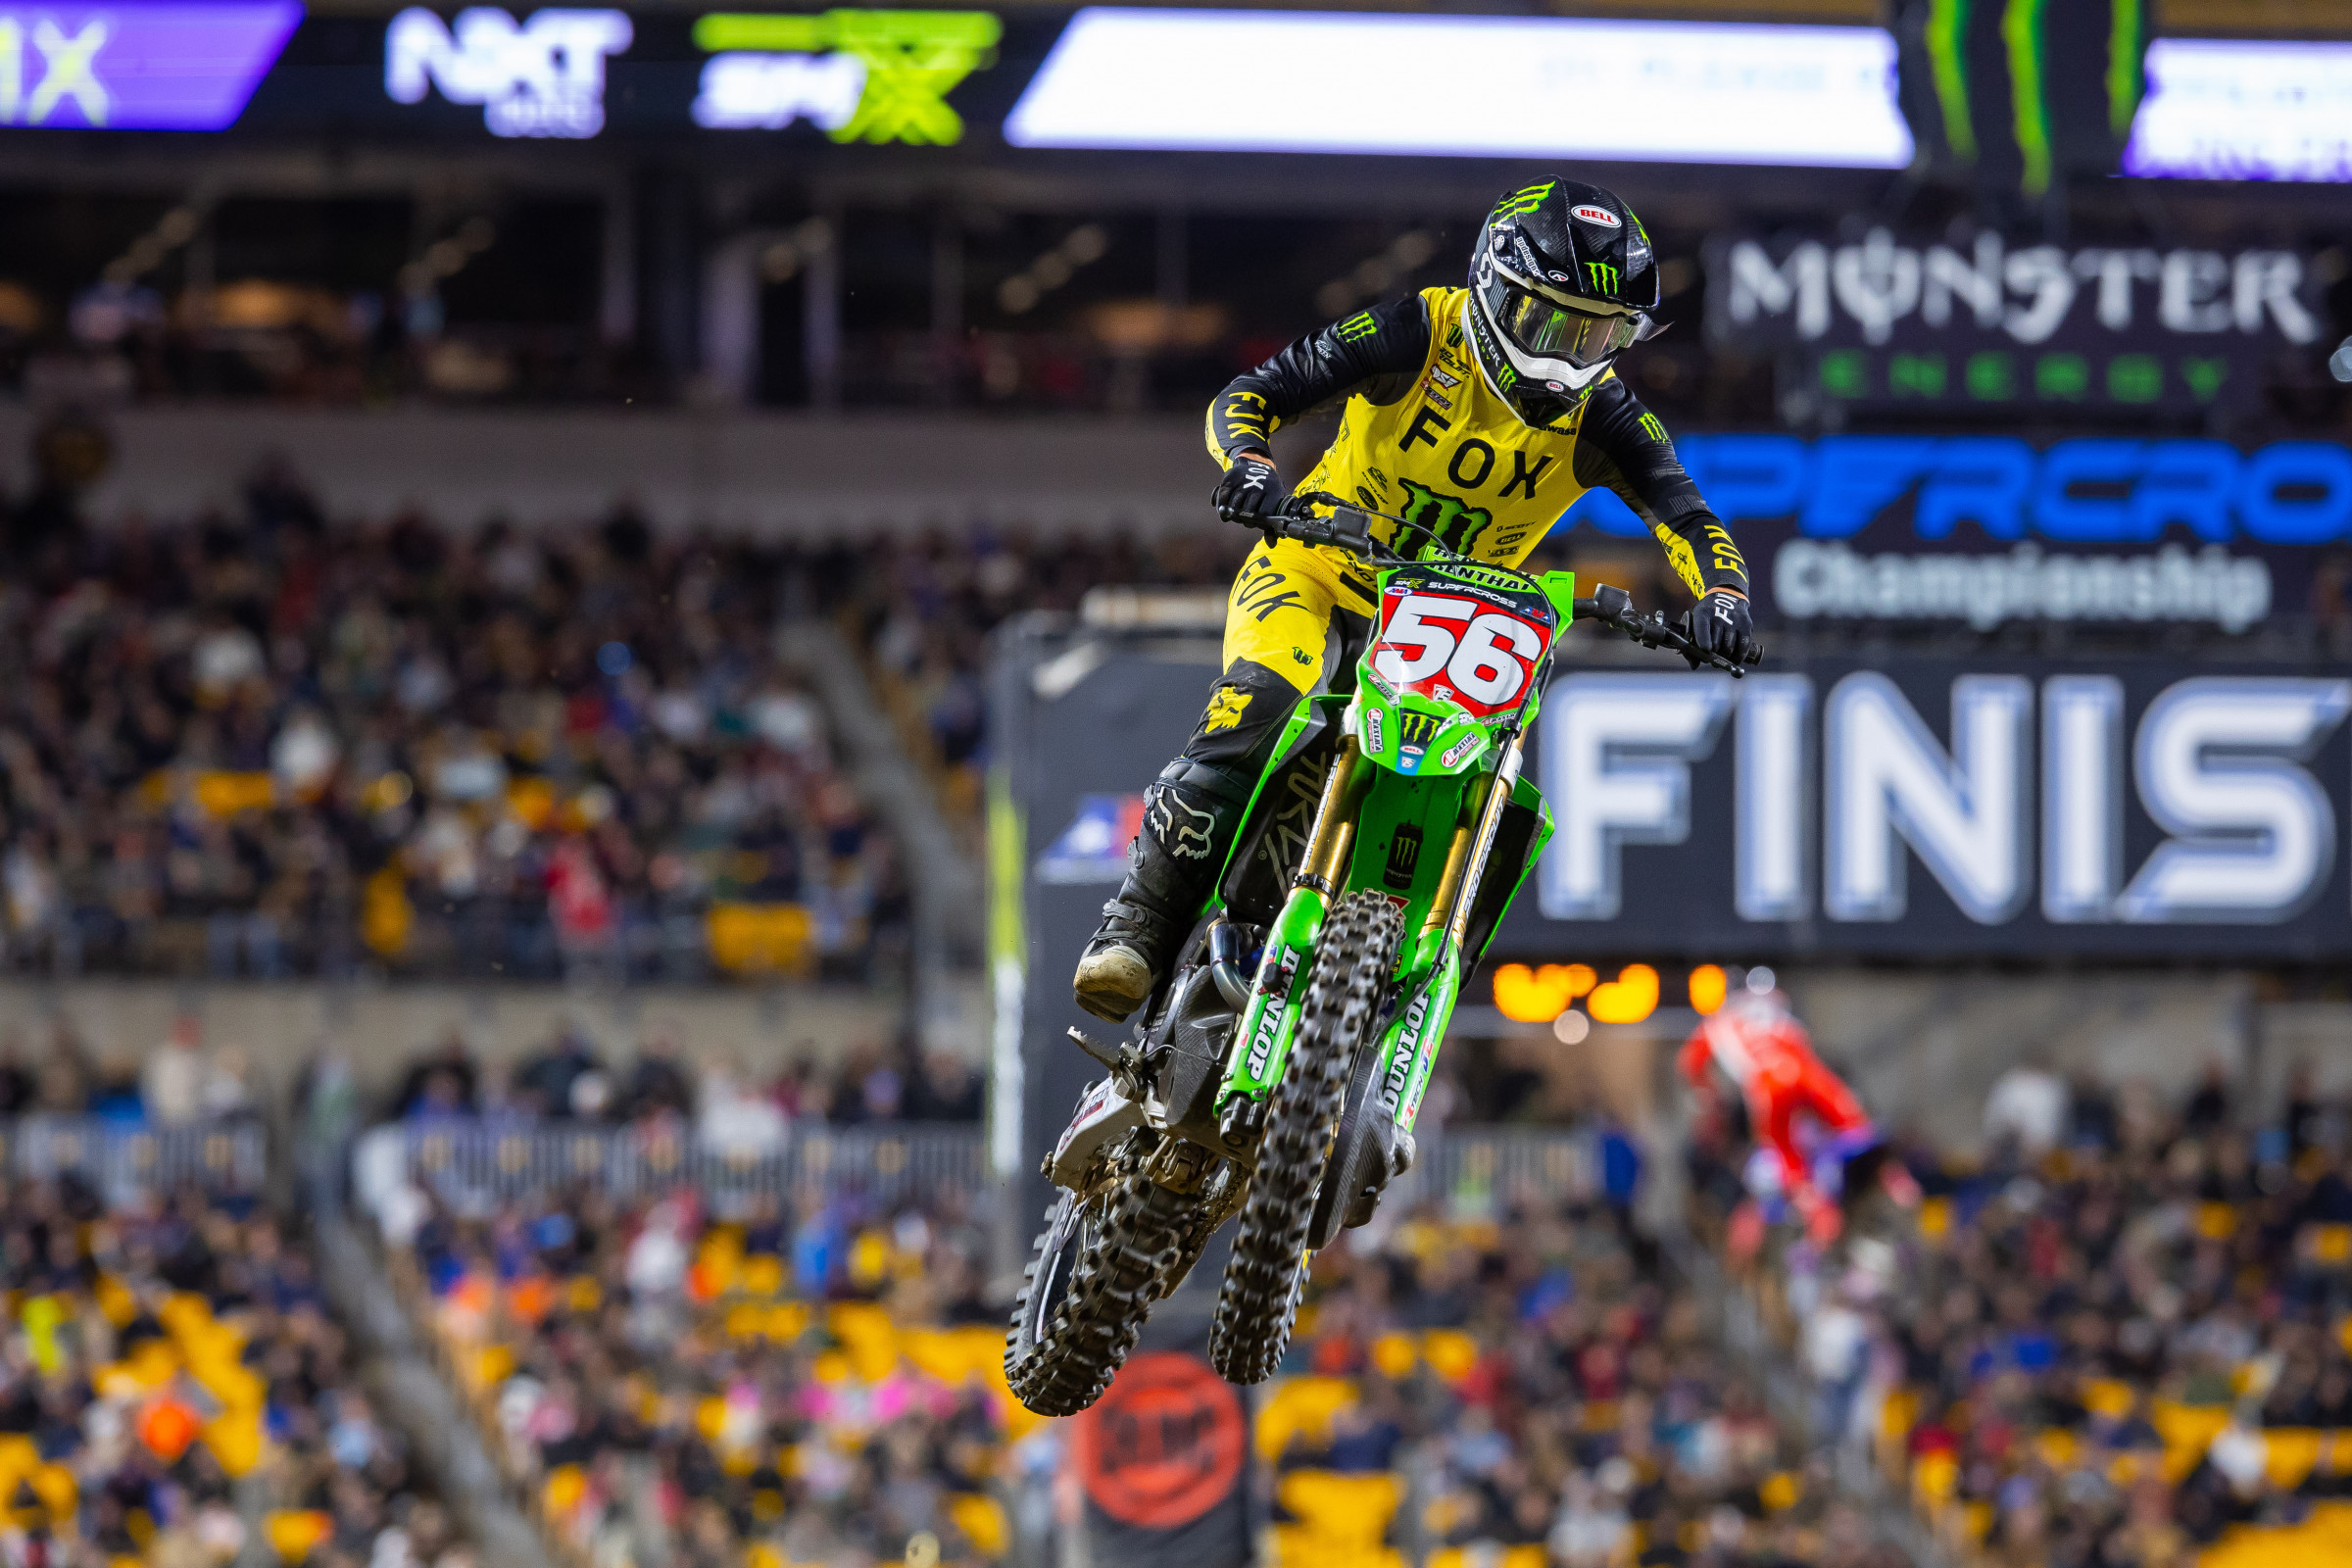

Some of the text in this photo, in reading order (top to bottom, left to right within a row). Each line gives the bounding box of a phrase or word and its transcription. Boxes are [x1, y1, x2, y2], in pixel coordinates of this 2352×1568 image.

[1580, 209, 1615, 224] BELL
[1730, 227, 2319, 345] MONSTER
[1243, 460, 1271, 490] FOX
[1398, 405, 1554, 500] FOX
[1427, 581, 1518, 609] SUPERCROSS
[1715, 591, 1738, 625] FOX
[1772, 538, 2271, 632] Championship
[1374, 595, 1542, 706] 56
